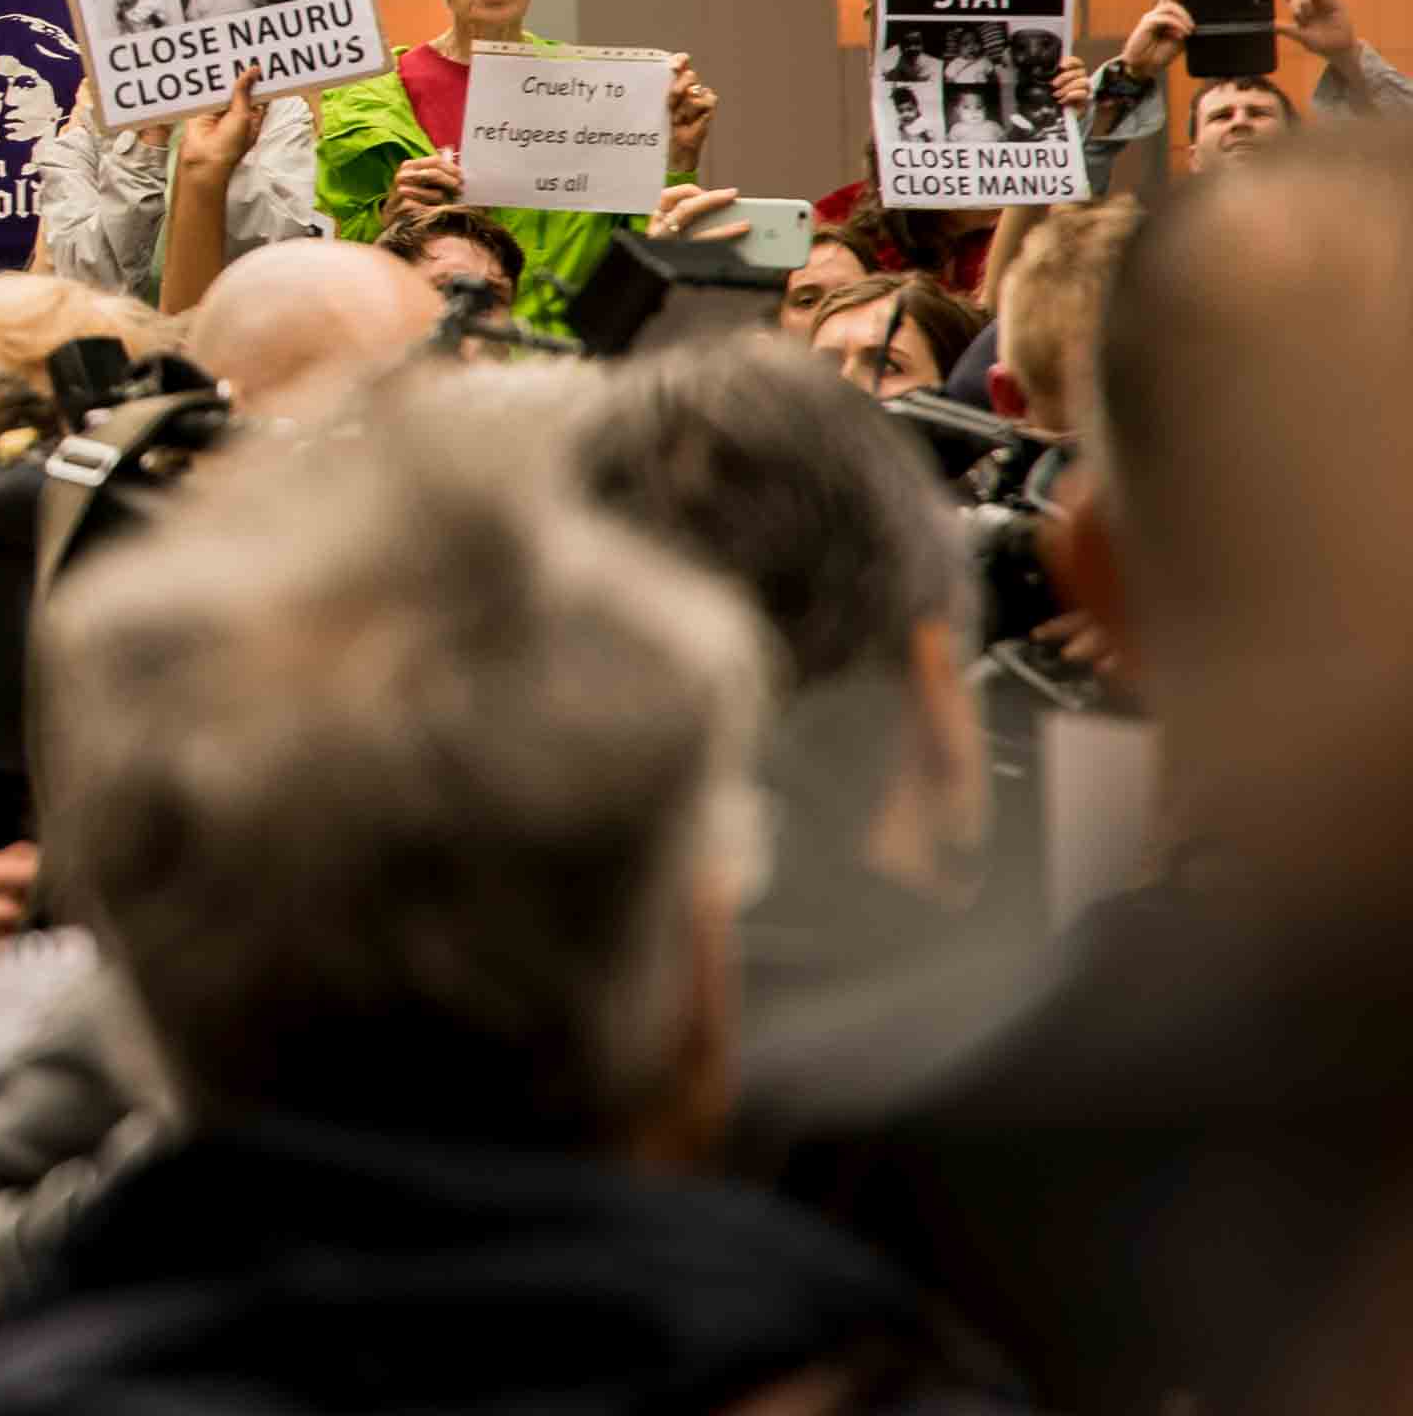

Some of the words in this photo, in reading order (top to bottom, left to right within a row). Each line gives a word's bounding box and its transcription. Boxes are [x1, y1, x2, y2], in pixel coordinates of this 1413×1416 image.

[108, 26, 221, 73] CLOSE
[114, 64, 226, 110] CLOSE
[522, 75, 598, 103] Cruelty
[605, 82, 626, 98] to
[473, 121, 569, 148] refugees
[573, 125, 660, 147] demeans
[892, 148, 970, 169] CLOSE
[978, 148, 1069, 169] NAURU
[534, 176, 559, 192] us
[564, 174, 590, 192] all
[893, 175, 972, 196] CLOSE
[978, 175, 1075, 196] MANUS
